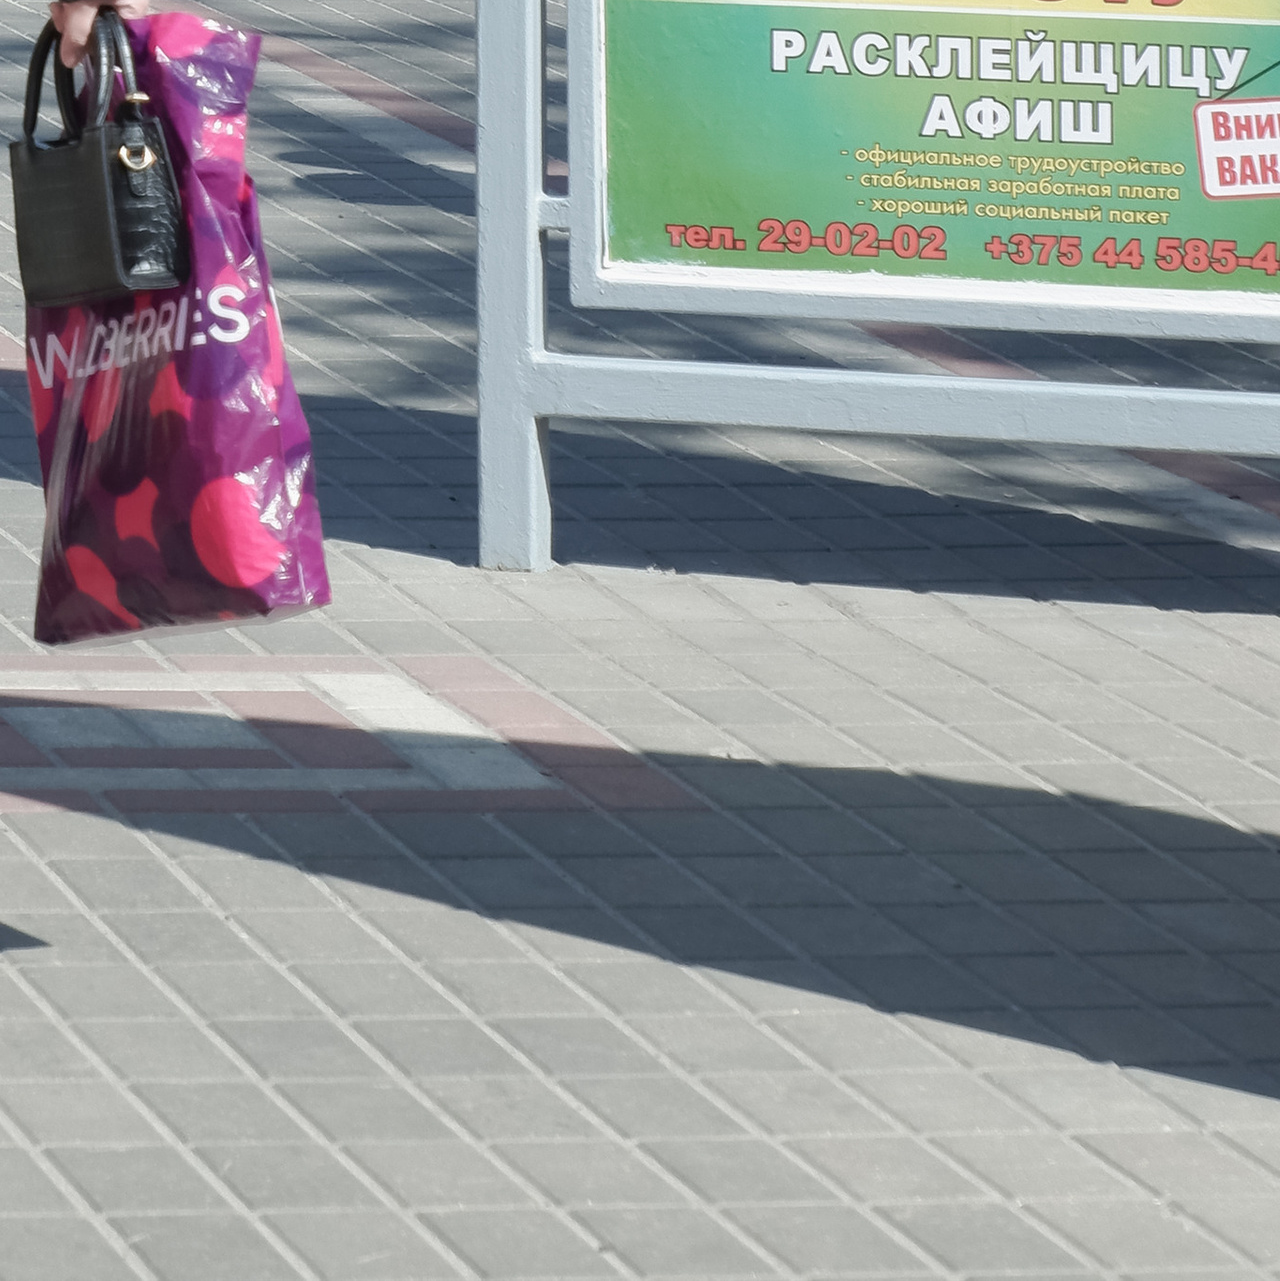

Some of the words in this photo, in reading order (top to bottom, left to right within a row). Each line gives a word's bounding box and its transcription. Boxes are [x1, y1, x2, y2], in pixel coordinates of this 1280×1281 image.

[770, 28, 1250, 98] РАСКЛЕЙЩИЦУ
[919, 93, 1114, 145] АФИШ
[855, 145, 1002, 173] официальное
[1009, 152, 1186, 177] трудоустройство
[860, 170, 981, 194] стабильная
[988, 178, 1112, 200] заработная
[1118, 185, 1181, 202] плата
[871, 196, 968, 218] хороший
[975, 202, 1104, 225] социальный
[1109, 208, 1170, 226] пакет
[666, 224, 746, 251] тел.
[757, 217, 948, 261] 29-02-02
[984, 234, 1083, 268] +375
[1093, 238, 1144, 271] 44
